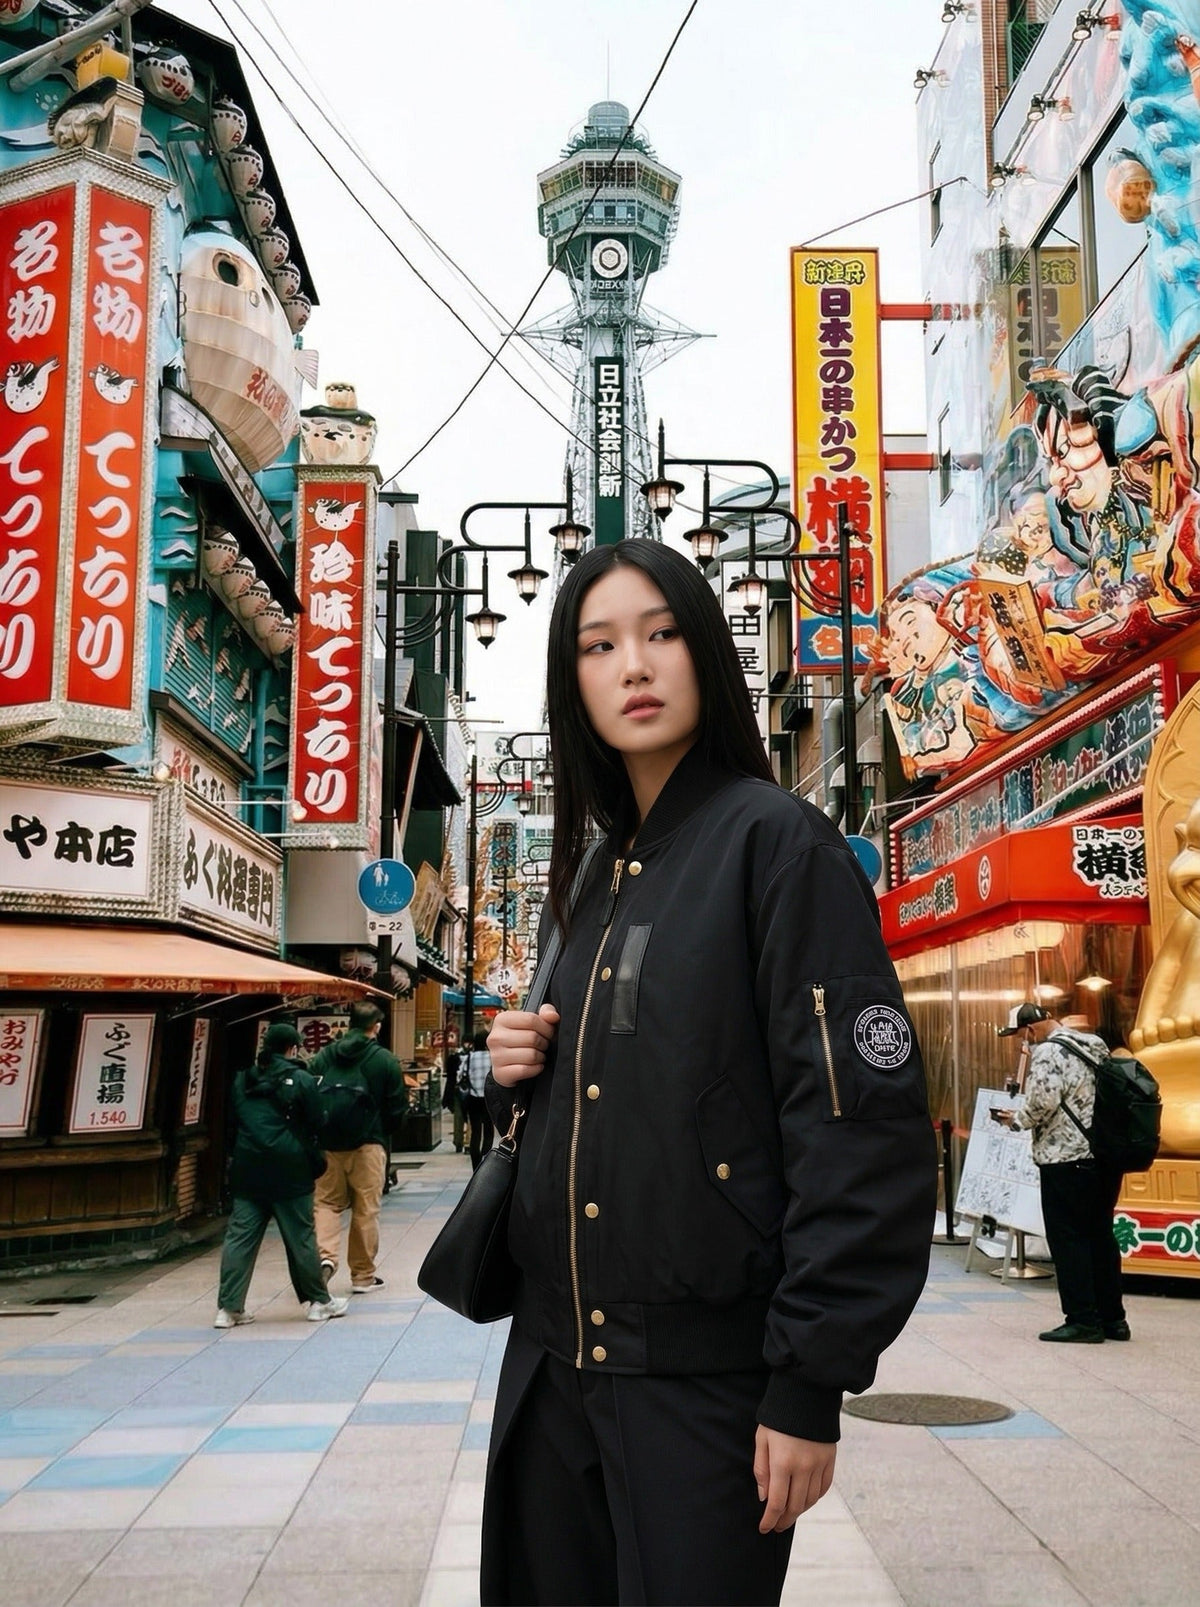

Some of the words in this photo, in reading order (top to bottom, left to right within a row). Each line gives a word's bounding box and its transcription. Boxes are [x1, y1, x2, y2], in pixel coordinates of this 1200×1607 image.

[7, 220, 58, 344] 名物
[94, 221, 144, 344] 名物
[818, 287, 857, 473] 日本一の串かつ
[0, 426, 49, 680] てっちり
[77, 431, 136, 681] てっちり
[302, 540, 355, 815] 珍味てっちり
[3, 814, 137, 868] や本店
[89, 1110, 127, 1126] 1.540
[1113, 1216, 1200, 1255] 本一の
